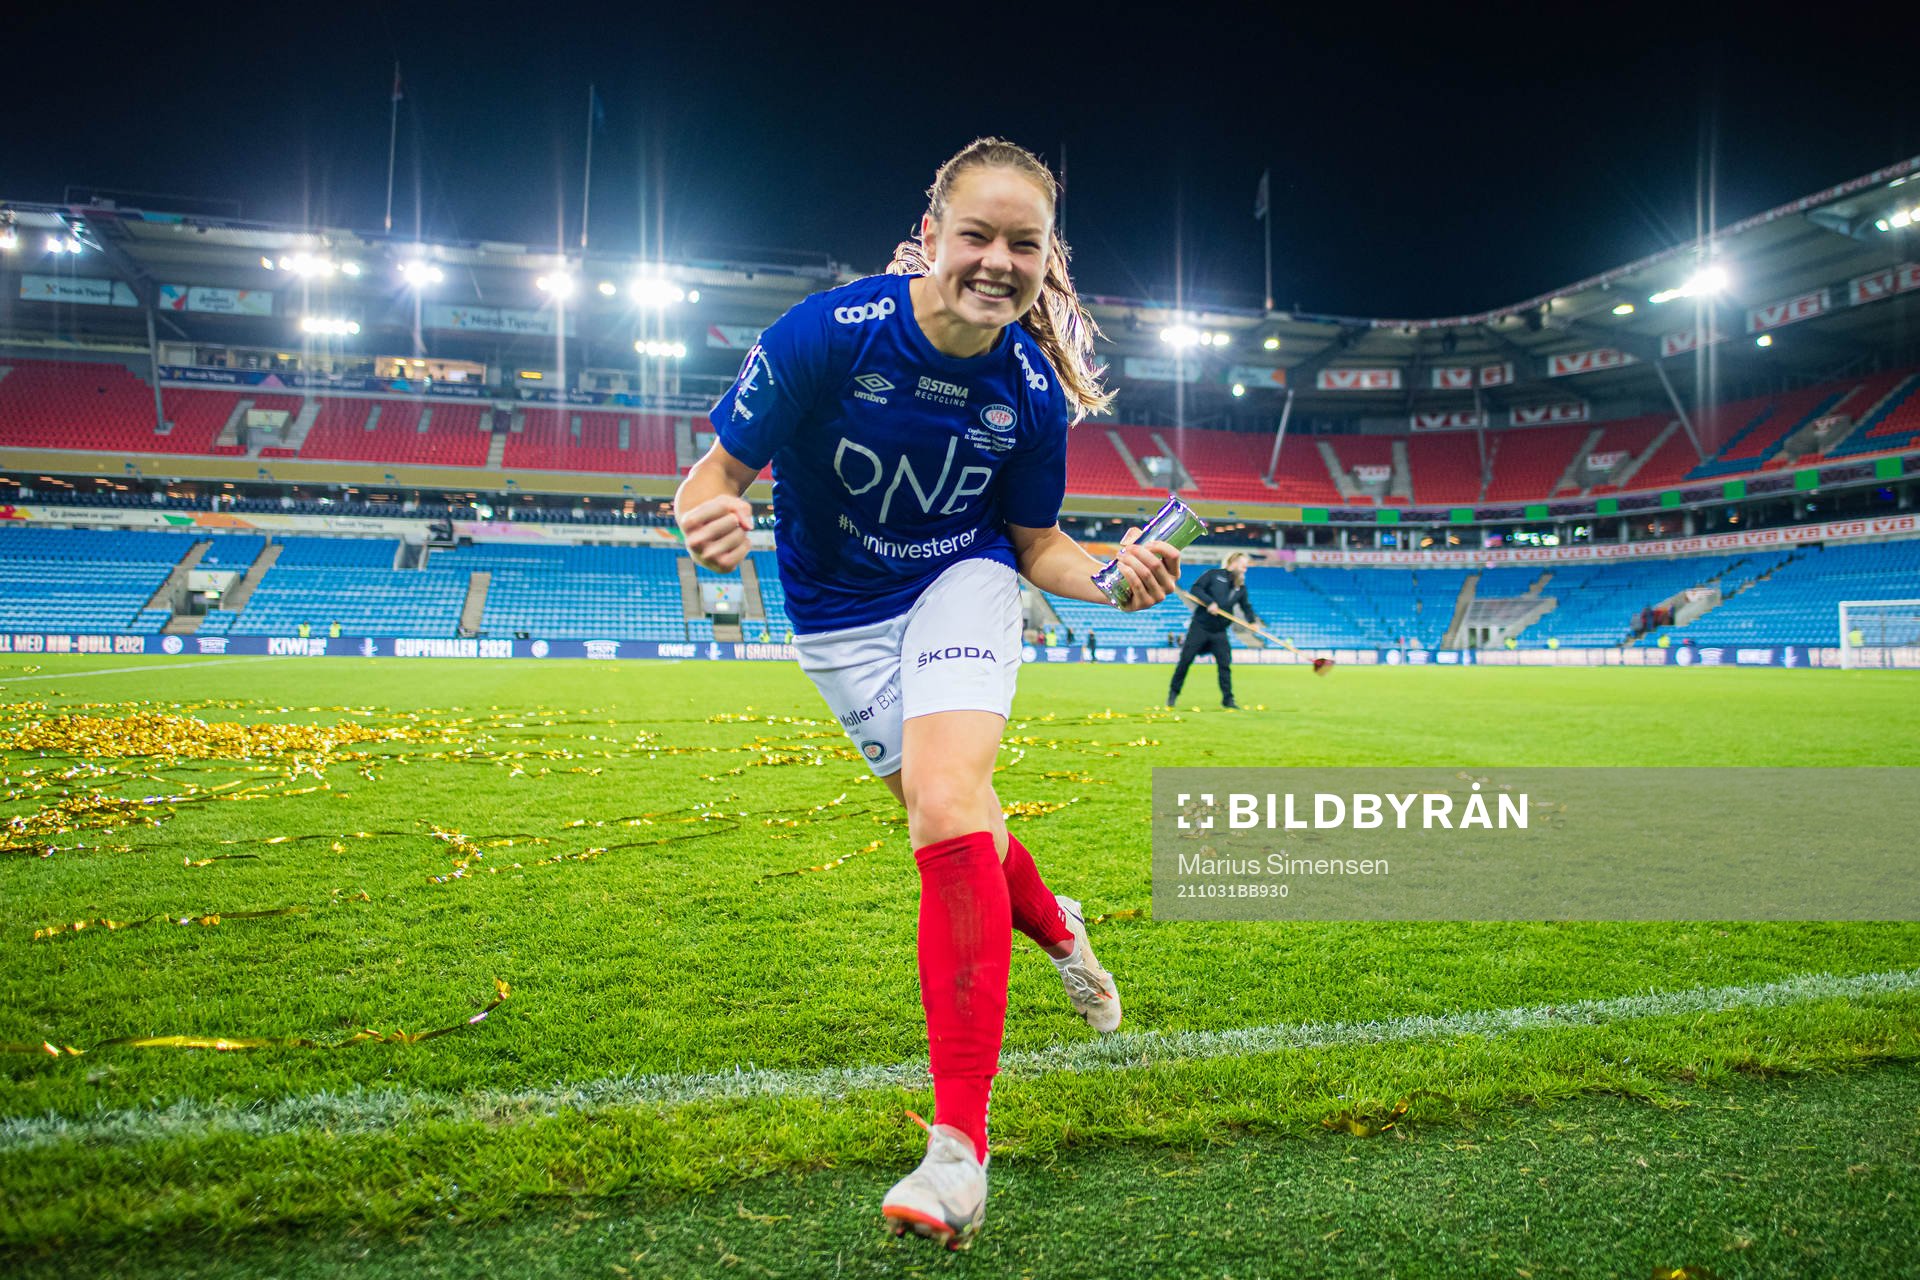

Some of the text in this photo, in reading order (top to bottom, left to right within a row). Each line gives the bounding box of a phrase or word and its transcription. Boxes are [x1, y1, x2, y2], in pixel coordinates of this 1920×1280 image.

[834, 297, 896, 324] coop
[1755, 294, 1820, 330] VG
[471, 315, 548, 331] Norsk Tipping
[1555, 350, 1625, 374] VG
[1326, 369, 1391, 388] VG
[1441, 363, 1507, 388] VG
[854, 390, 888, 405] umbro
[915, 389, 966, 407] RECYCLING
[930, 380, 969, 398] STENA
[1416, 411, 1480, 428] VG
[1515, 403, 1582, 423] VG
[833, 436, 992, 523] DNB
[1744, 531, 1777, 544] VG
[1784, 527, 1820, 541] VG
[1827, 522, 1865, 538] VG
[1872, 517, 1914, 533] VG
[14, 635, 43, 652] MED
[115, 636, 144, 654] 2021
[268, 637, 308, 656] KIWI
[395, 638, 513, 658] CUPFINALEN 2021
[876, 688, 897, 711] Bil
